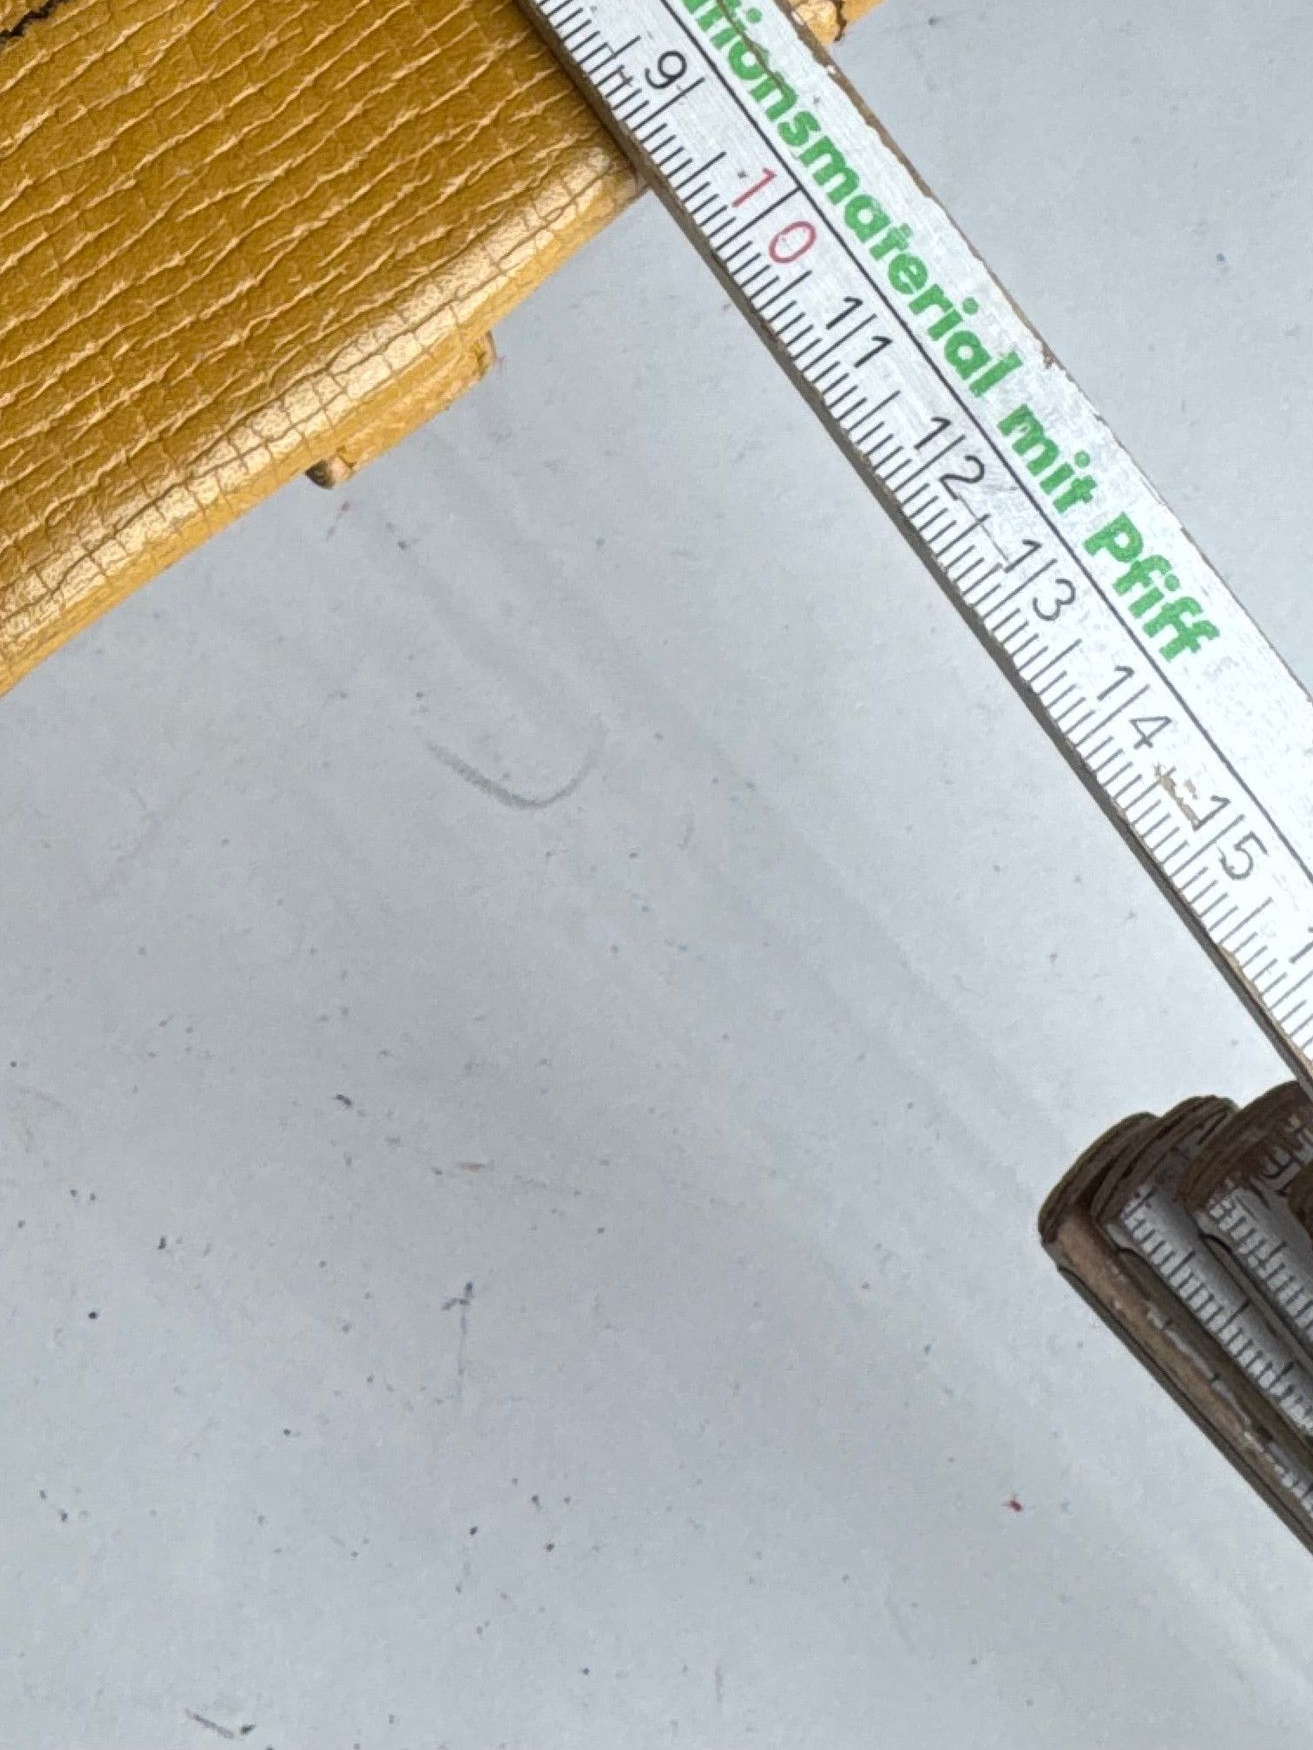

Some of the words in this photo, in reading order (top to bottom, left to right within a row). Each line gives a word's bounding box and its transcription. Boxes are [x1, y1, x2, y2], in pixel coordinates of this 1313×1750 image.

[644, 50, 688, 90] 9
[731, 166, 818, 265] 10
[825, 296, 894, 369] 11
[913, 416, 986, 501] 12
[1004, 538, 1077, 622] 13
[1096, 665, 1174, 750] 14
[1192, 795, 1269, 881] 15
[998, 403, 1097, 514] mit
[1083, 512, 1220, 661] Pfiff
